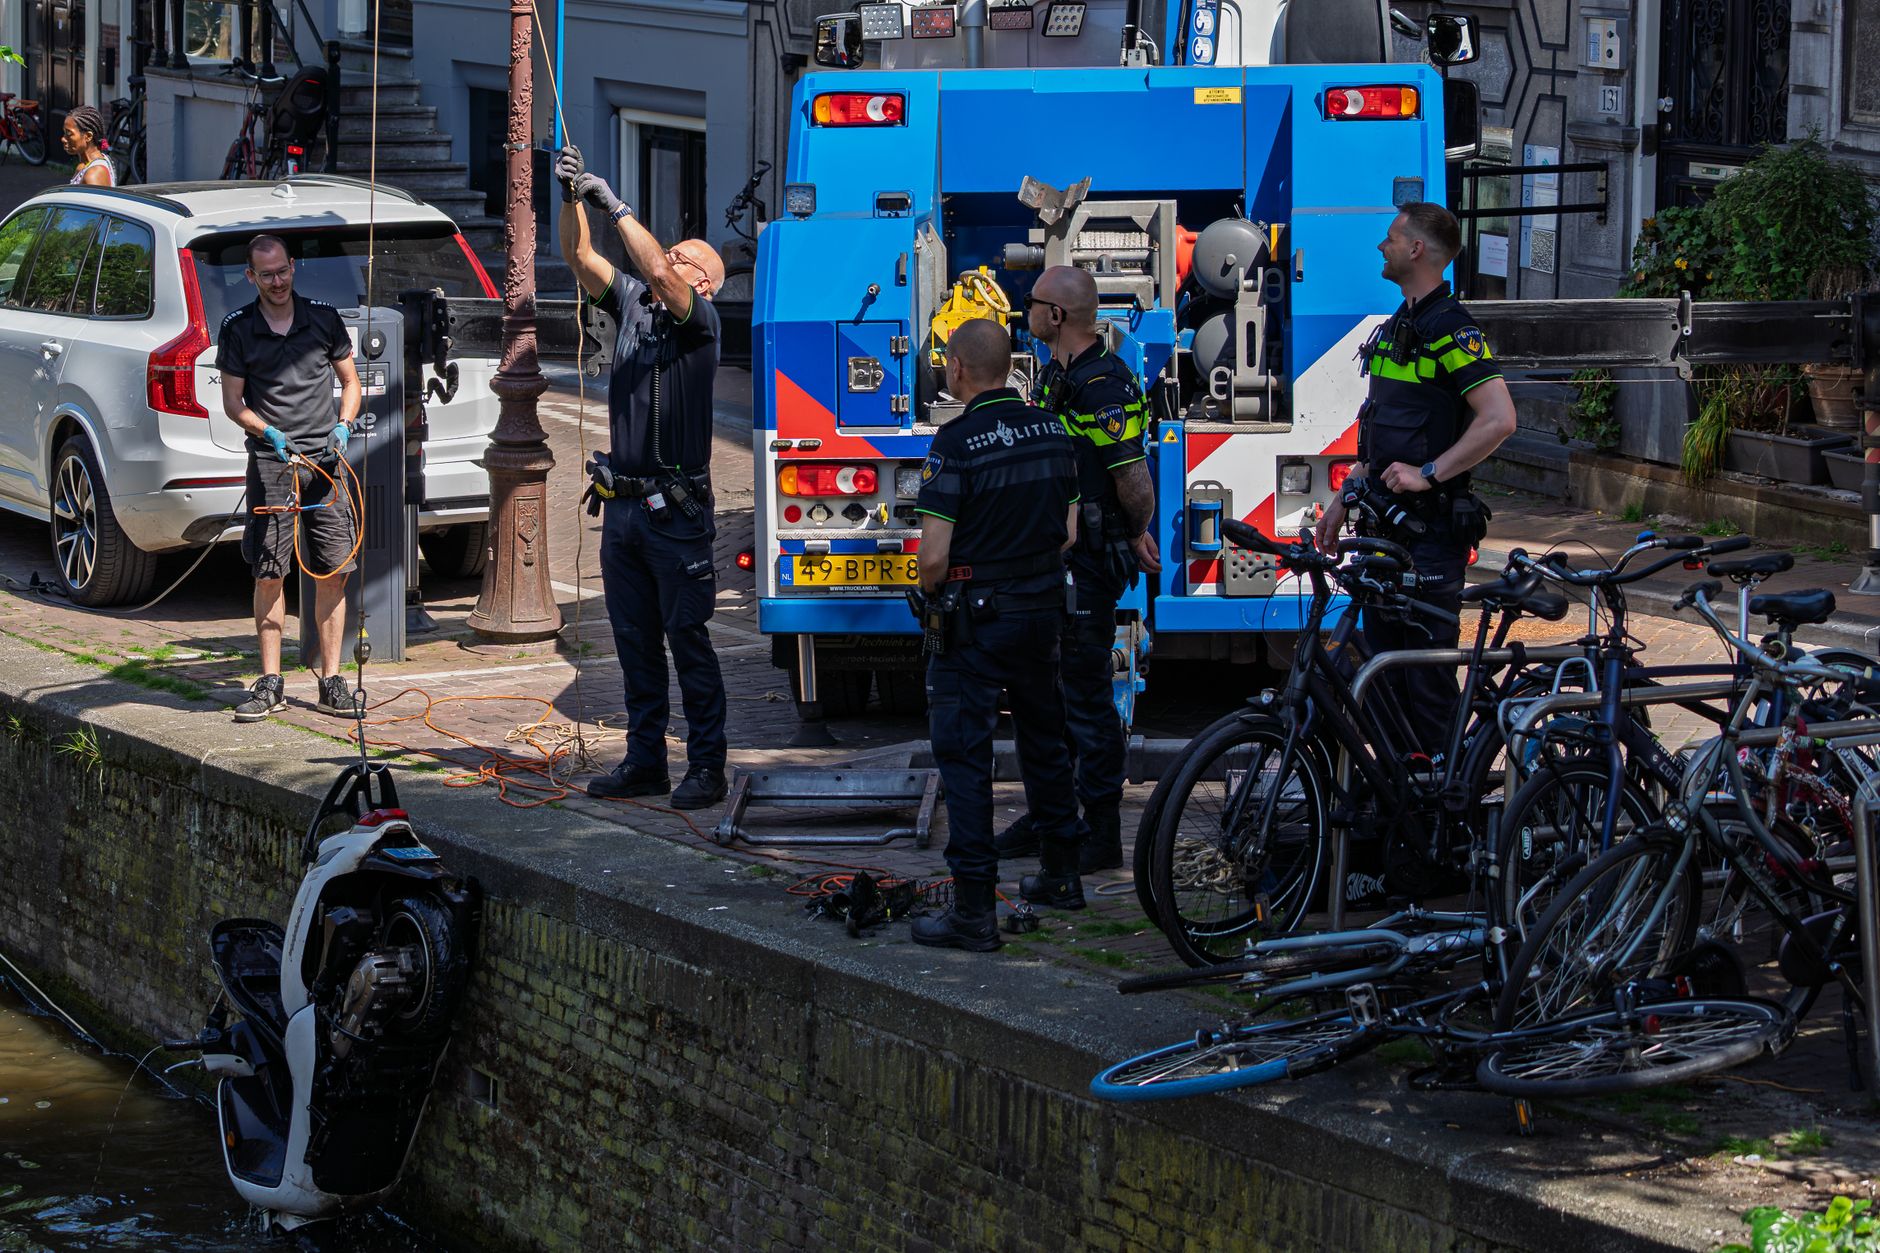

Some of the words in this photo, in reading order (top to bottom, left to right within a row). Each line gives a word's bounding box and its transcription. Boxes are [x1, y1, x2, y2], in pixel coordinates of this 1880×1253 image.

[1602, 89, 1618, 112] 131
[1526, 149, 1533, 160] 3
[1524, 190, 1530, 201] 2
[1457, 330, 1480, 339] POLITIE
[1098, 408, 1121, 420] POLITIE
[986, 420, 1058, 446] POLITIE
[801, 559, 918, 581] 49-BPR-8
[781, 573, 792, 581] NL
[1346, 872, 1386, 901] GNETAR
